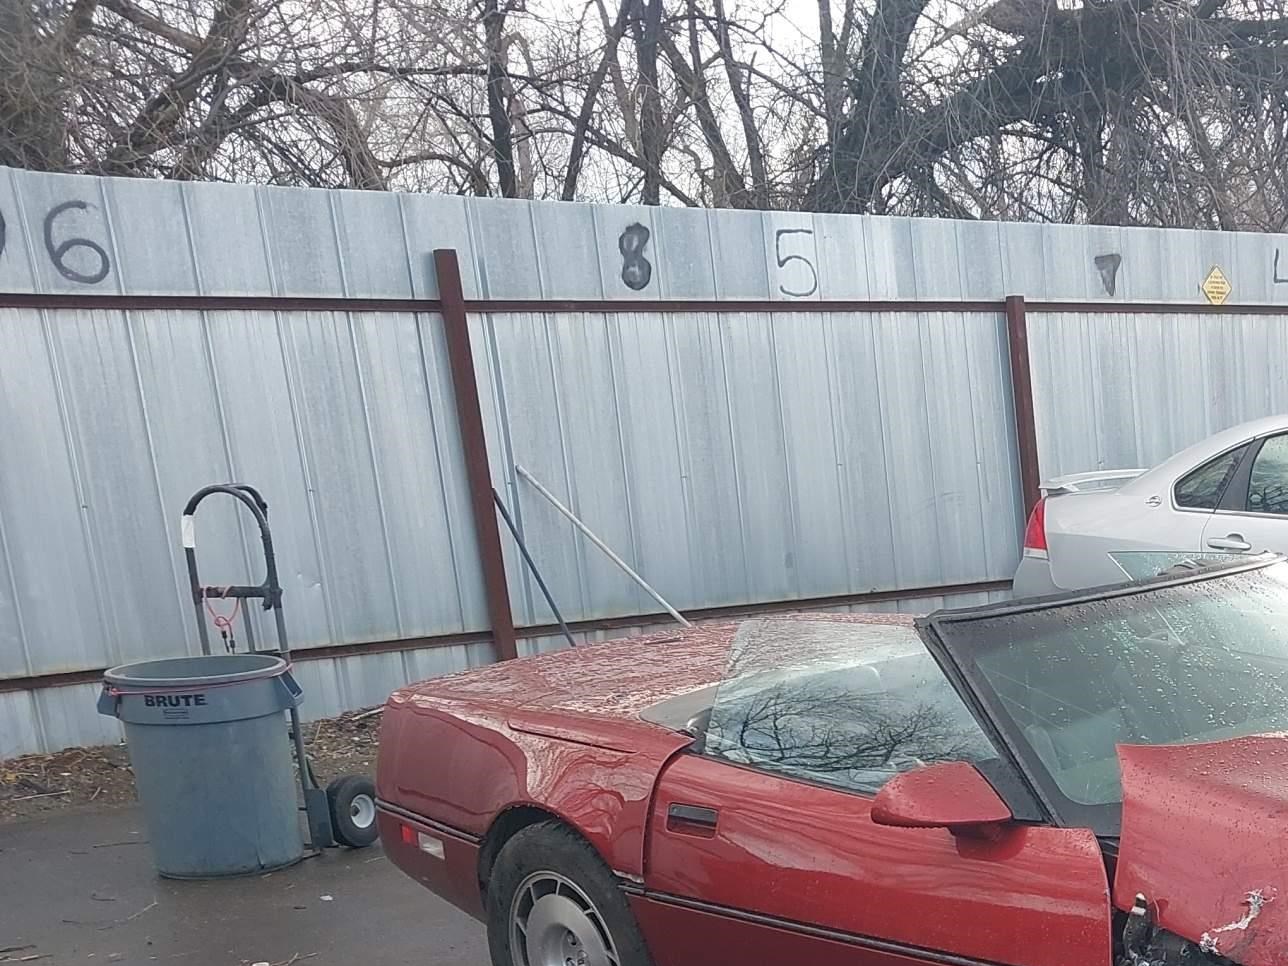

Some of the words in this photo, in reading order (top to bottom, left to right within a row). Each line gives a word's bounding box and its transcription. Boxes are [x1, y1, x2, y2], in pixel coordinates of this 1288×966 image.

[44, 200, 110, 284] 6
[776, 229, 818, 297] 5
[143, 694, 209, 707] BRUTE
